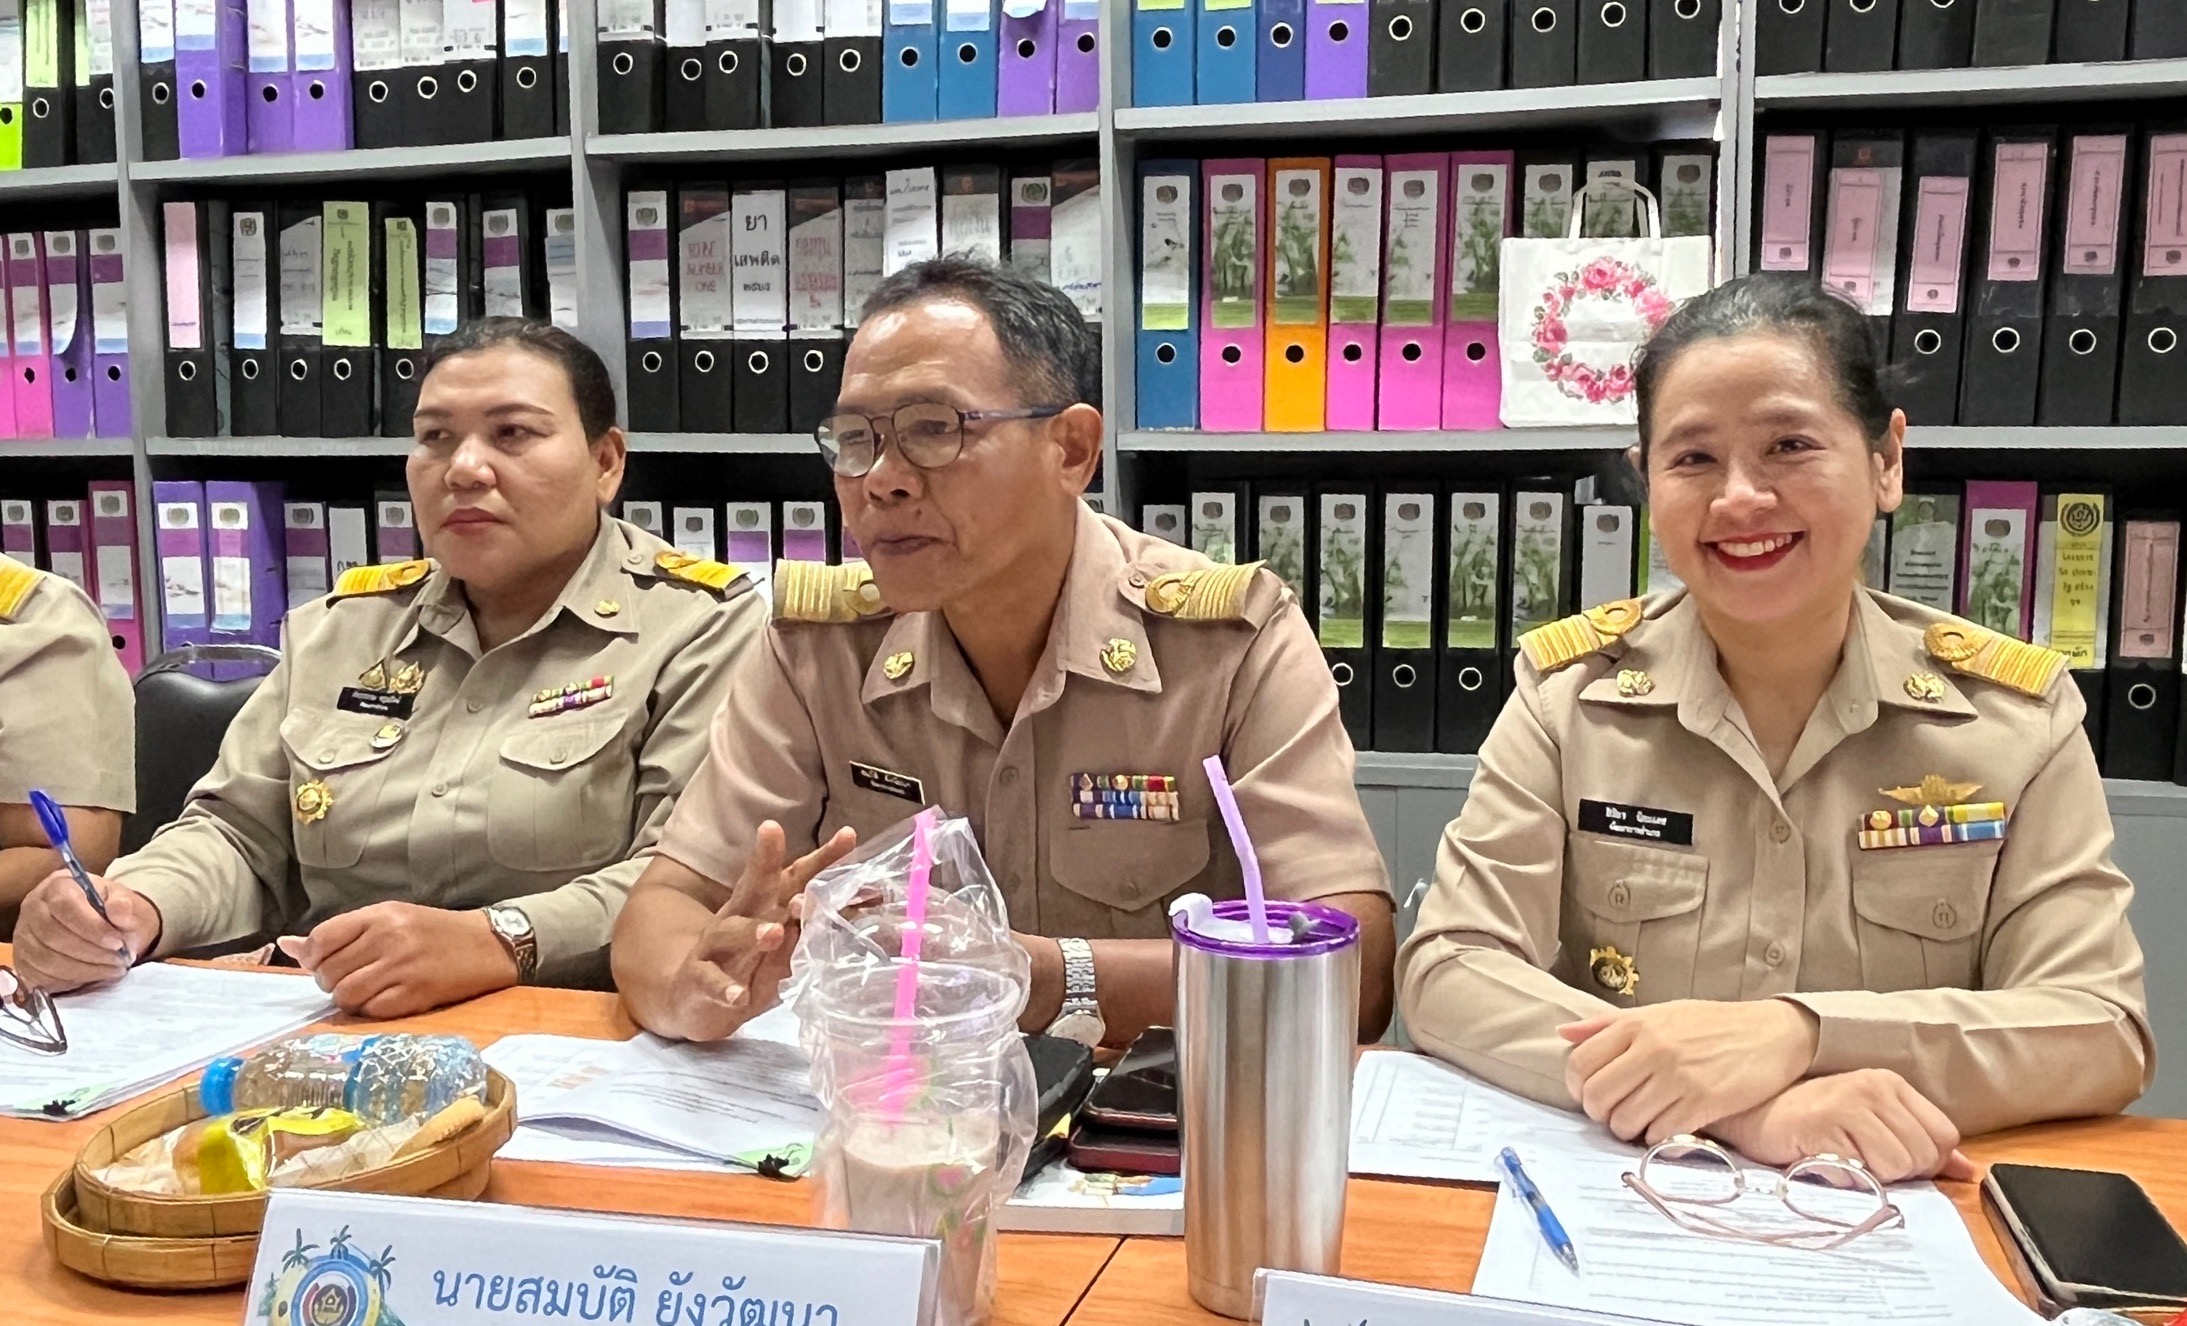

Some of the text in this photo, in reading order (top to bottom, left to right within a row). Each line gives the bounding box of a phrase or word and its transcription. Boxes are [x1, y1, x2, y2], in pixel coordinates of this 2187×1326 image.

[745, 214, 768, 232] ยา
[734, 250, 781, 267] เสพติด
[432, 1264, 839, 1326] นายสมบัติ ยังวัฒนา
